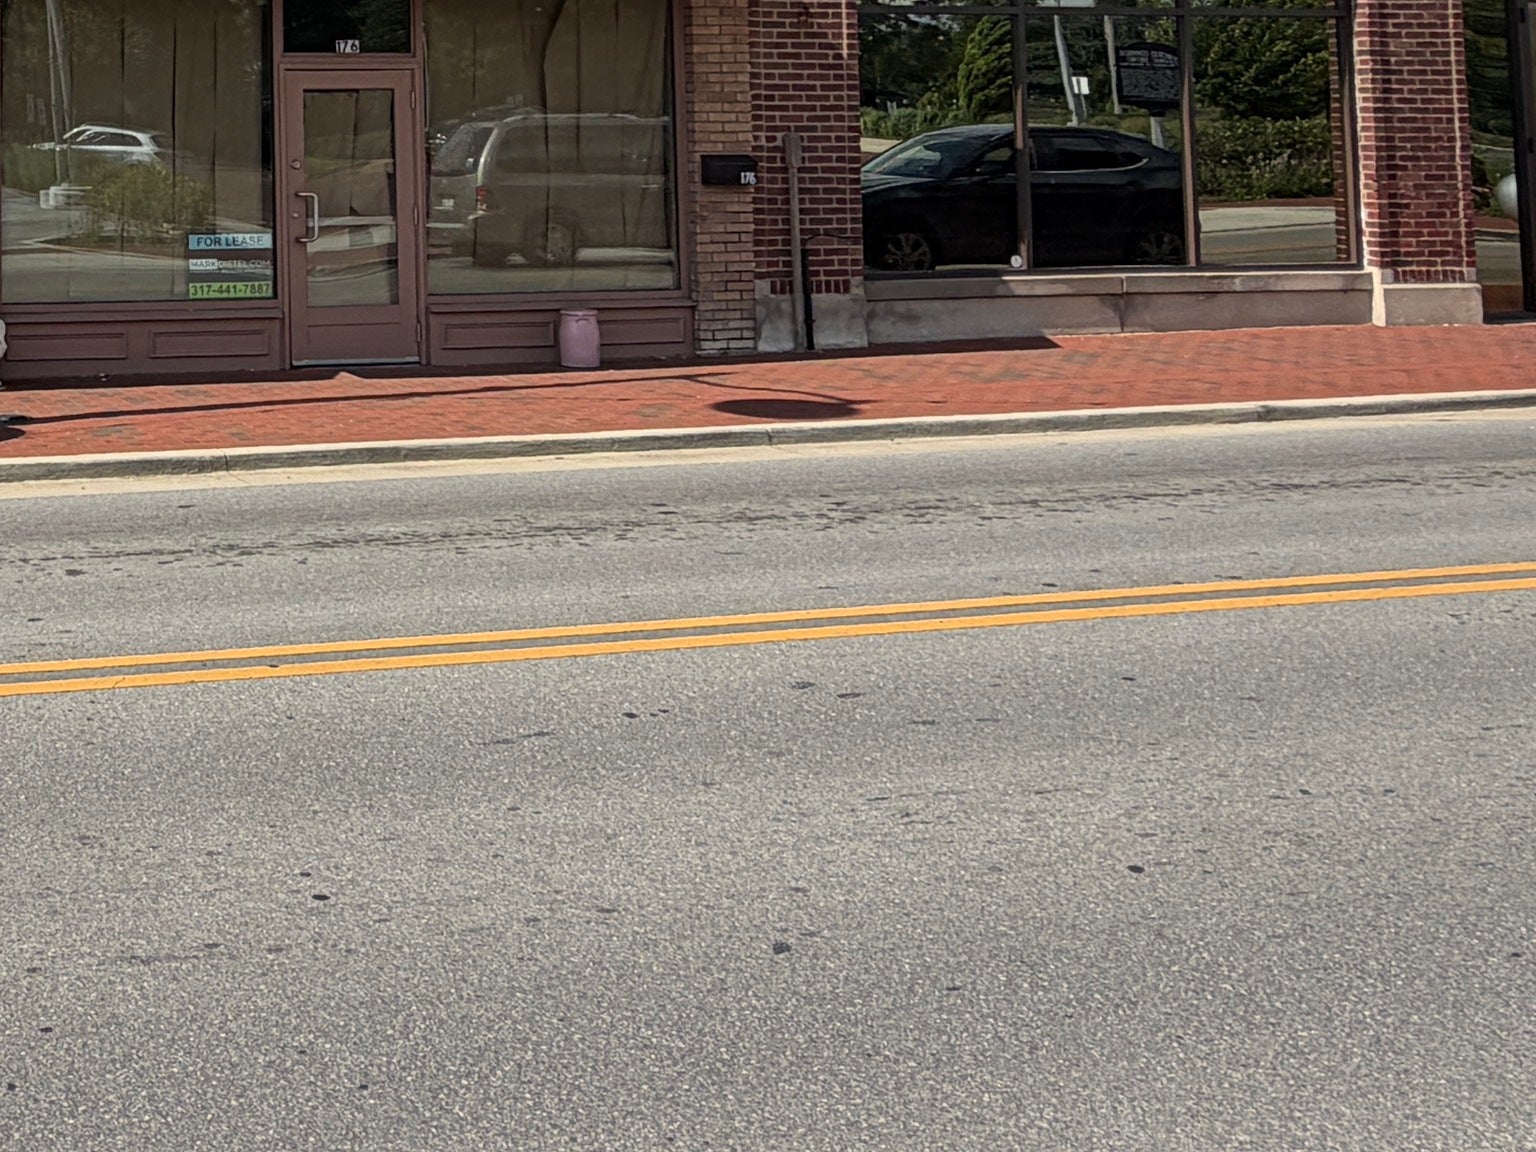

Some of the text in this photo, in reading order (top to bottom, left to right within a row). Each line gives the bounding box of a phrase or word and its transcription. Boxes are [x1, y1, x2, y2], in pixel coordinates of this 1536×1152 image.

[336, 41, 359, 53] 176
[741, 172, 756, 185] 176
[196, 235, 264, 247] FOR LEASE
[190, 283, 270, 296] 317-441-7887
